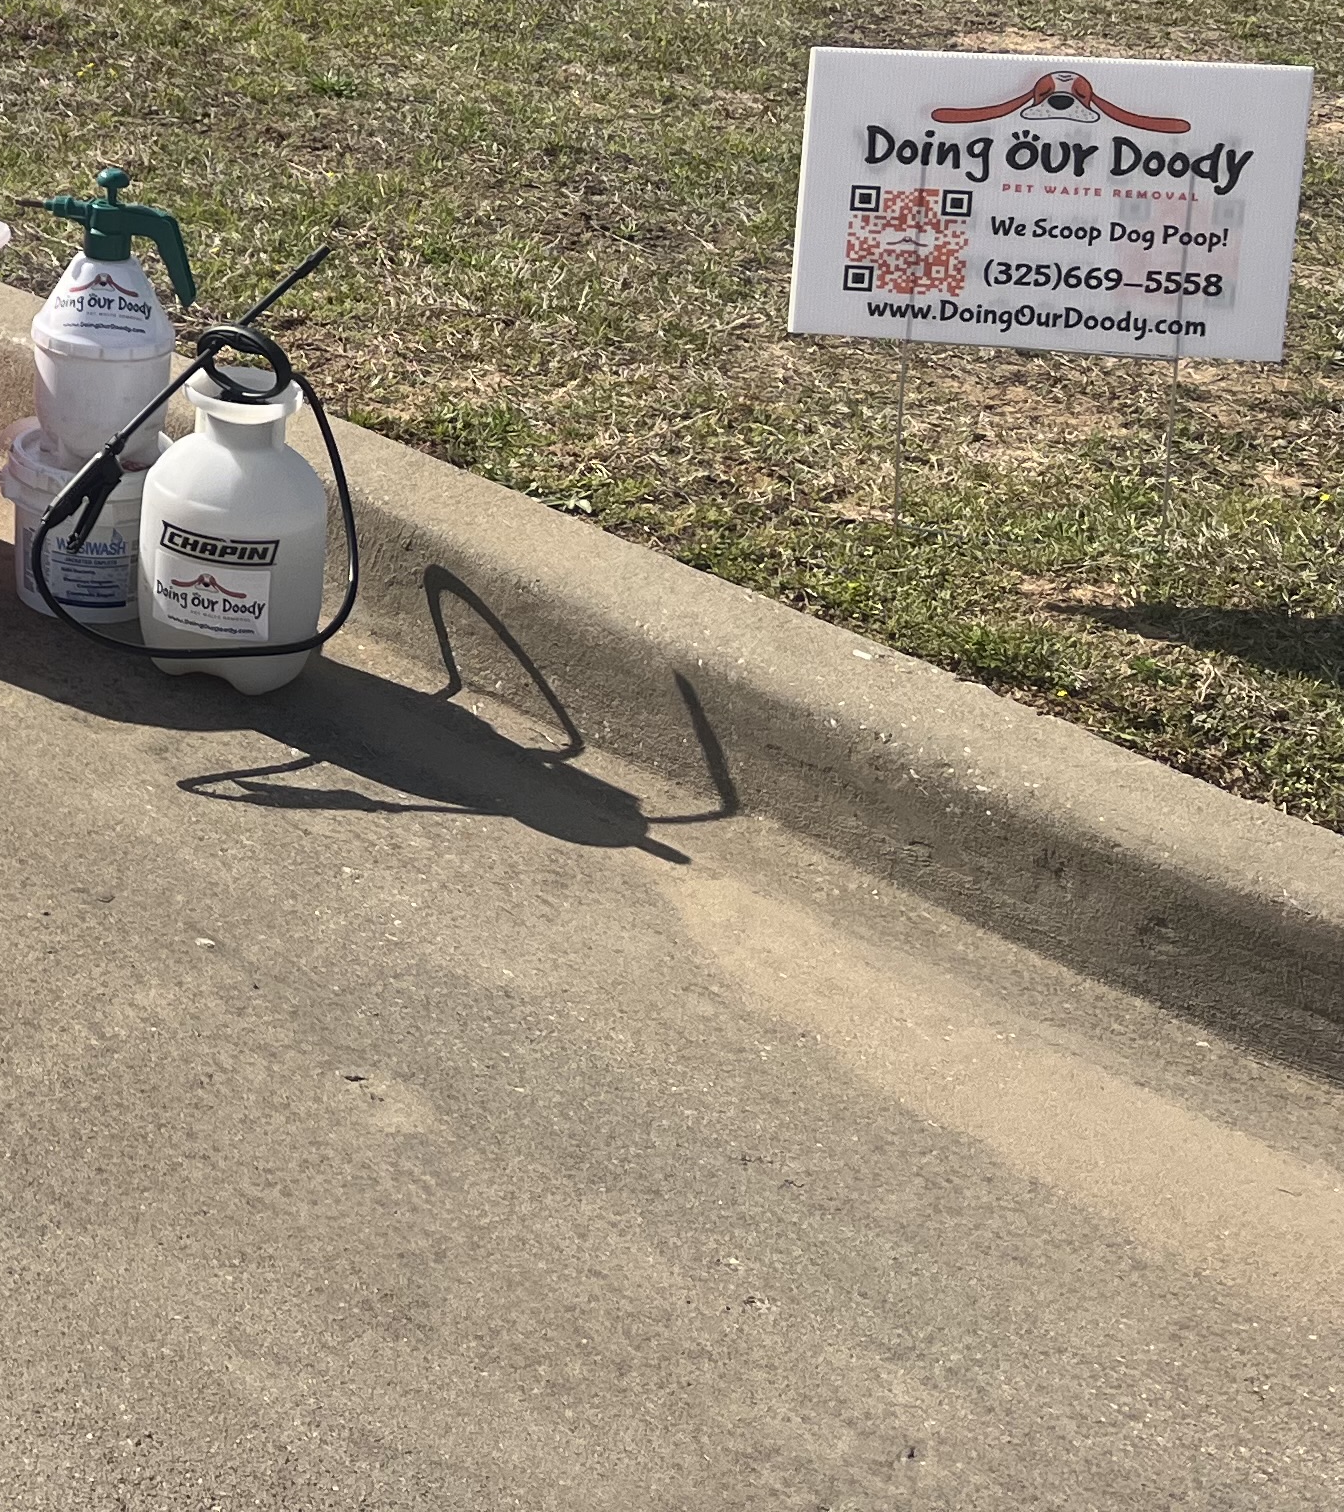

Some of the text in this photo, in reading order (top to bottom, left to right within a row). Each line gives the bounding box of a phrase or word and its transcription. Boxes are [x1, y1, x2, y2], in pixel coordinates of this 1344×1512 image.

[864, 124, 994, 183] Doing
[1109, 136, 1255, 196] Doody
[1001, 183, 1200, 202] PET WASTE REMOVAL
[990, 216, 1230, 253] We Scoop Dog Poop!
[54, 294, 85, 313] Doing
[118, 295, 152, 320] Doody
[866, 299, 1207, 341] www.DoingOurDoody.com
[56, 536, 127, 556] WSIWASH
[167, 531, 270, 561] CHAPIN
[156, 579, 188, 610] Doing
[222, 598, 266, 620] Doody
